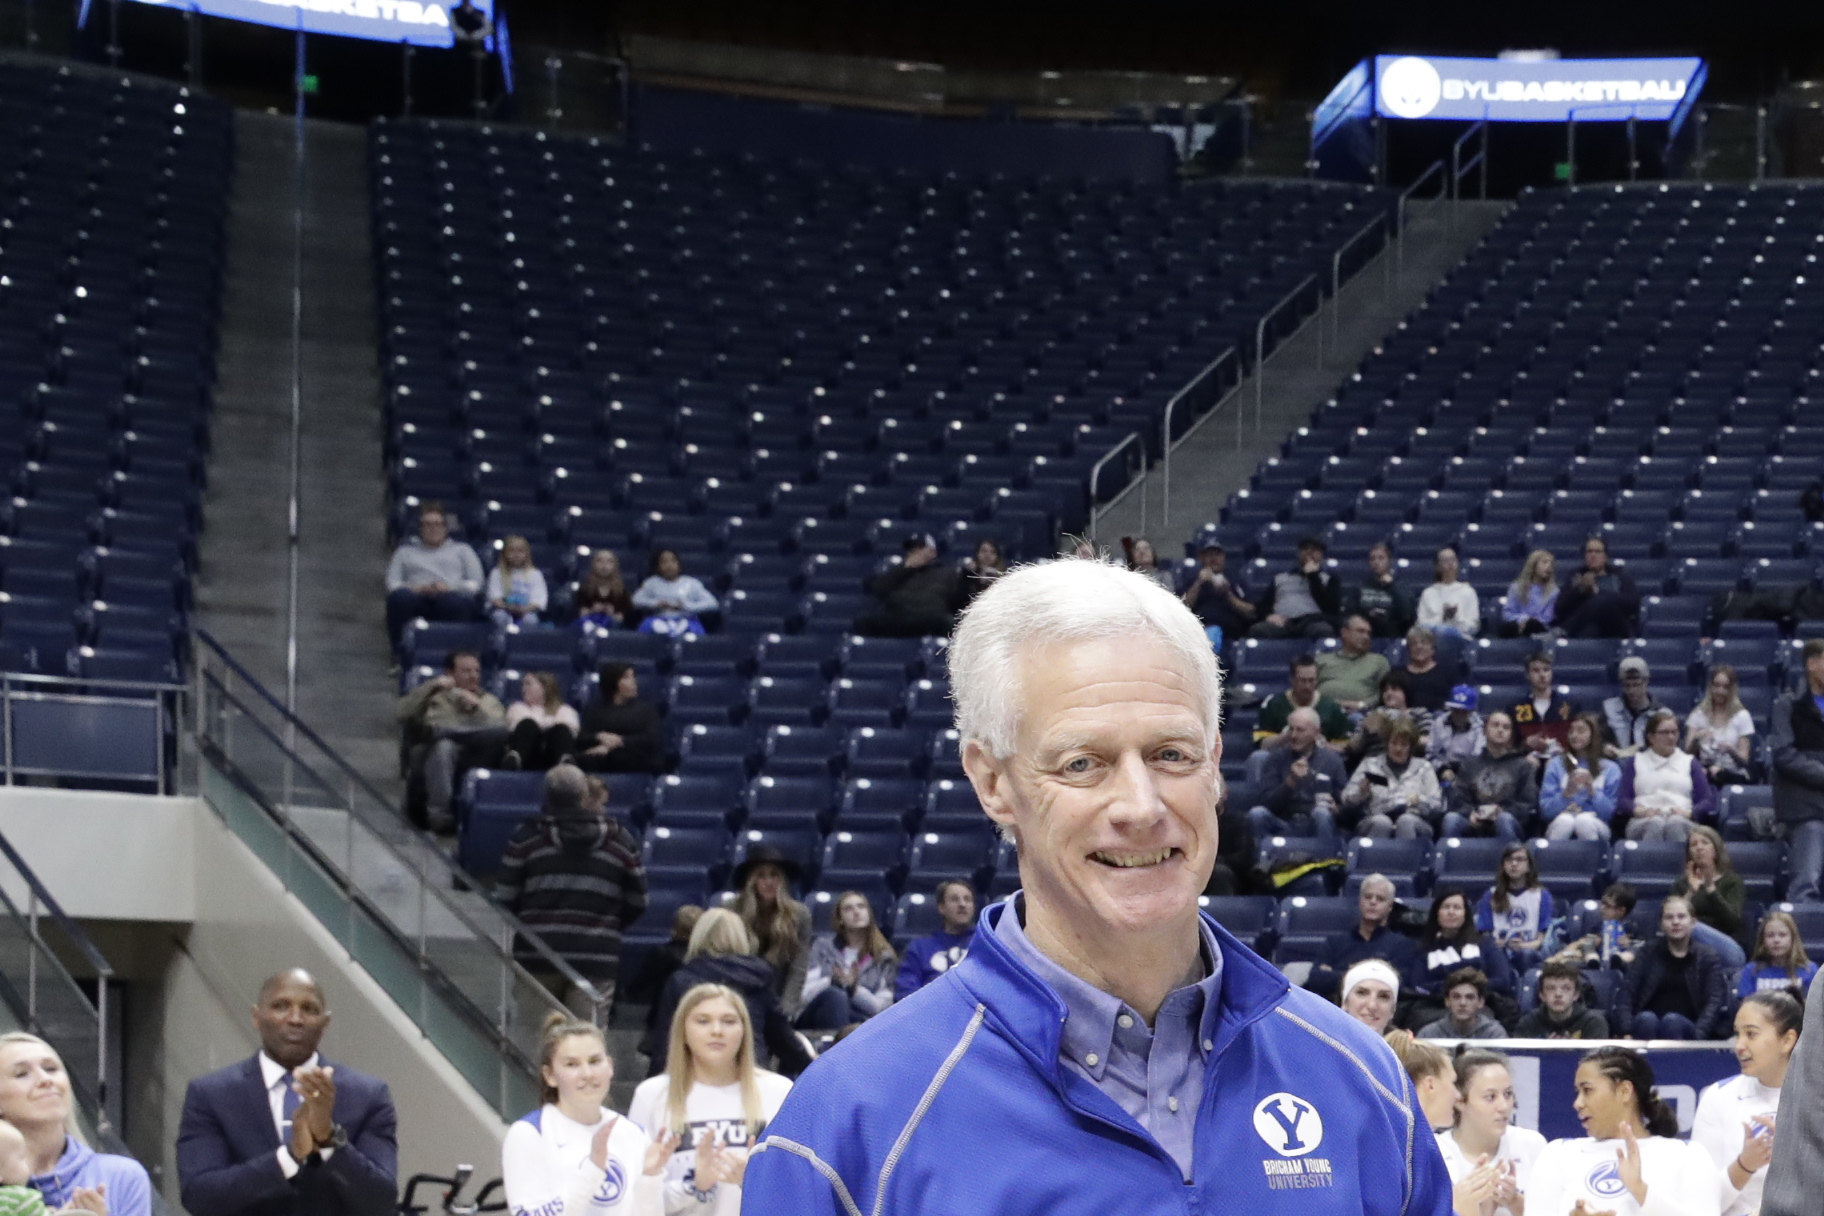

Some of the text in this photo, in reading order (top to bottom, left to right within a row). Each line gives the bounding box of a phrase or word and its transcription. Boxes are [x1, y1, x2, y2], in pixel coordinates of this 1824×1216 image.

[1262, 1098, 1310, 1150] Y
[1263, 1158, 1332, 1175] BRIGHAM YOUNG
[1267, 1173, 1333, 1190] UNIVERSITY
